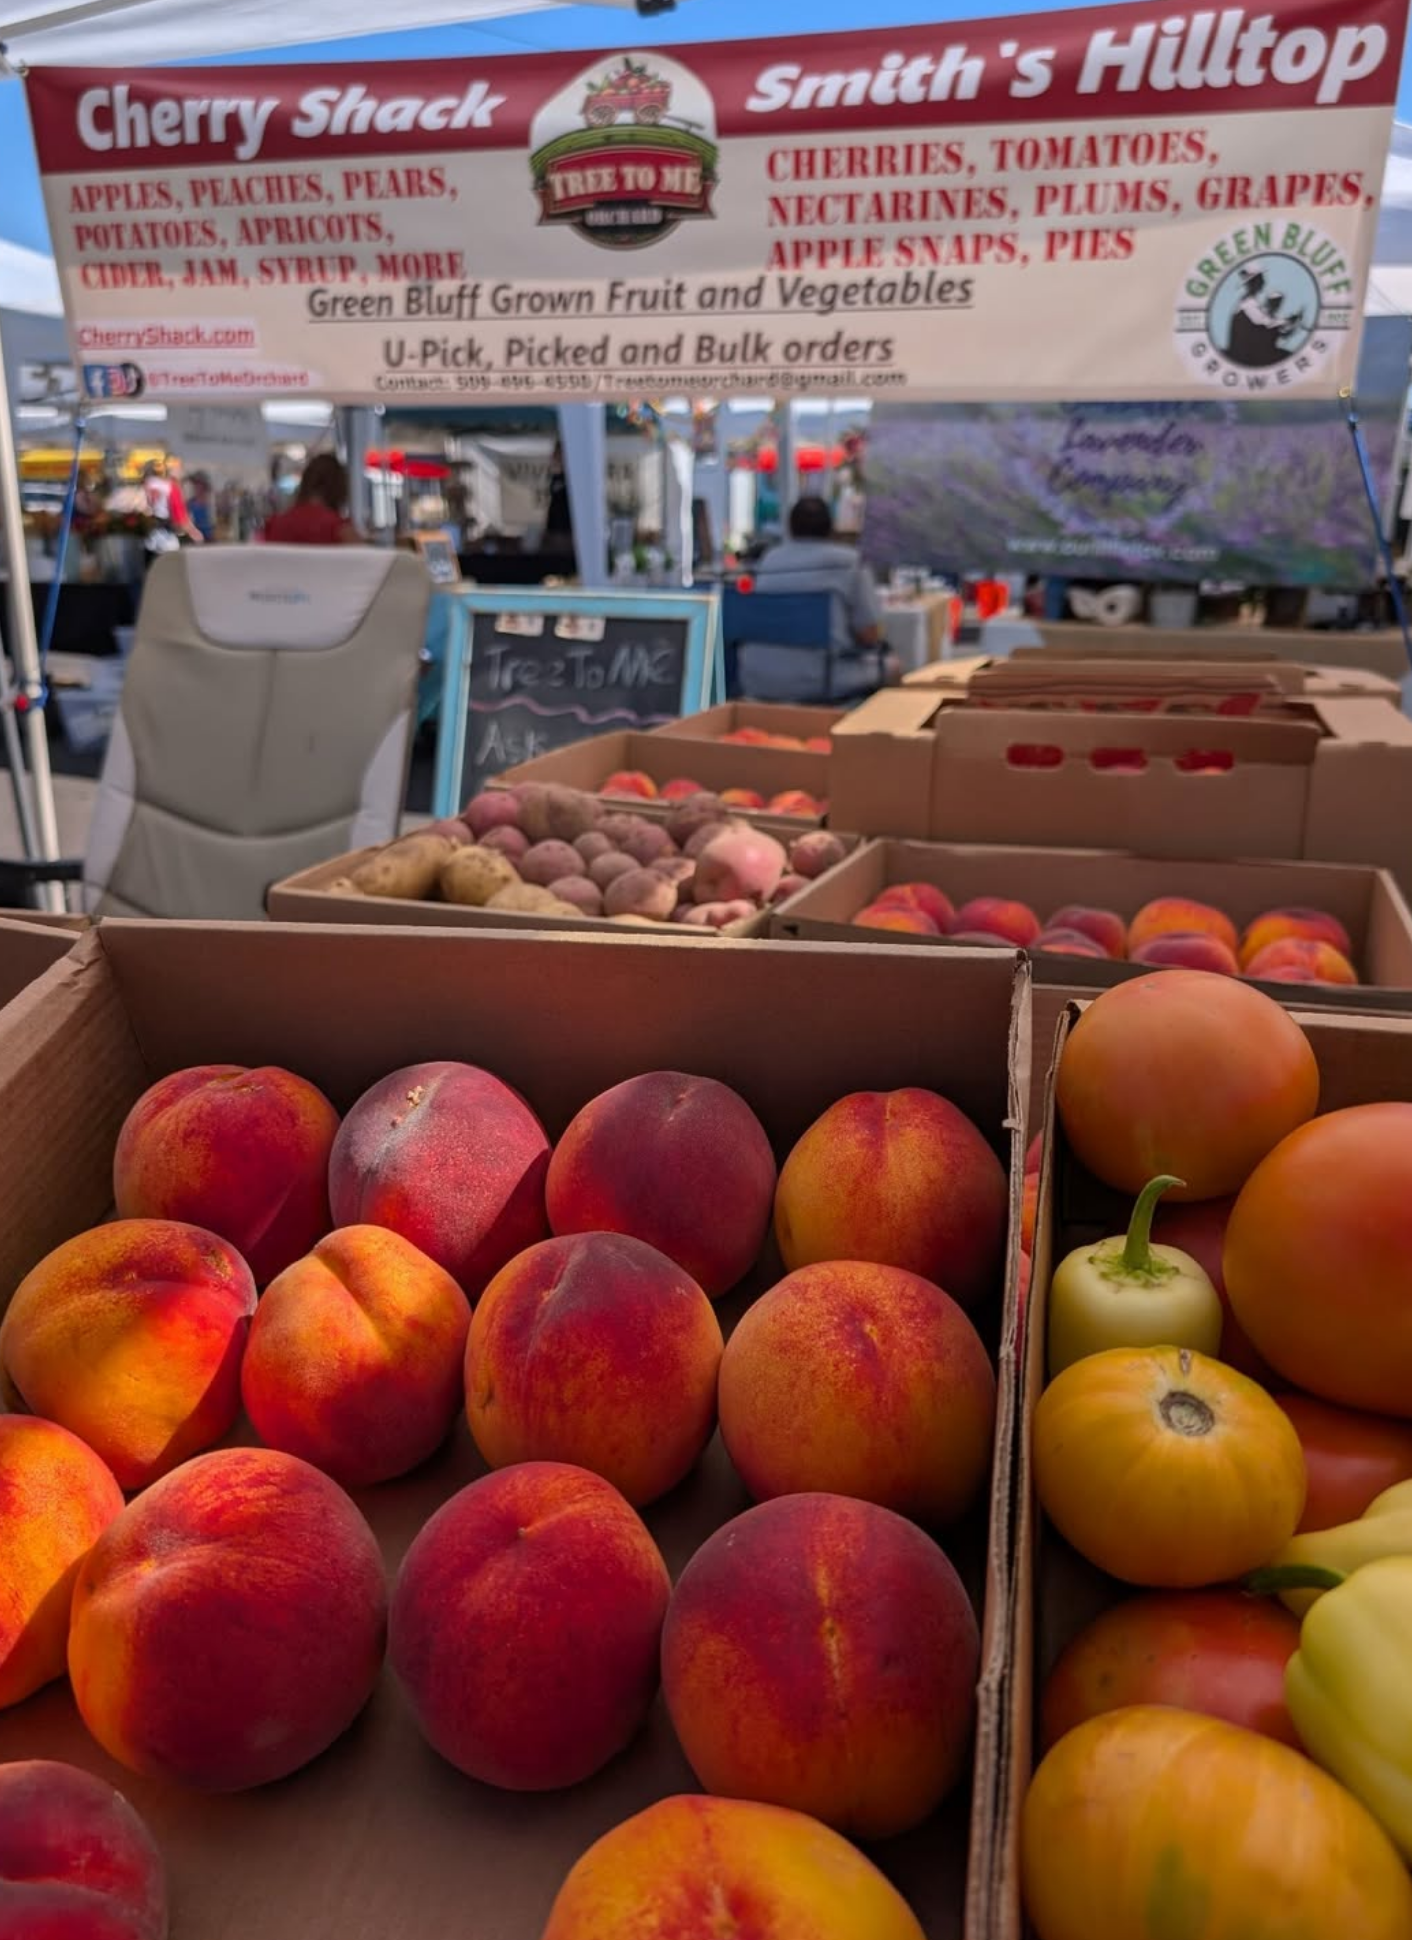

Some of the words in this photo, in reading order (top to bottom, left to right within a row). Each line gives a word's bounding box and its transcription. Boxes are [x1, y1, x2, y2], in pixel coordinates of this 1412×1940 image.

[1076, 8, 1389, 105] Hilltop
[76, 83, 279, 162] Cherry
[291, 80, 507, 139] Shack
[765, 142, 977, 182] CHERRIES,
[990, 130, 1220, 171] TOMATOES,
[69, 181, 184, 215] APPLES,
[189, 173, 334, 210] PEACHES,
[342, 167, 459, 202] PEARS,
[547, 166, 617, 201] TREE
[622, 164, 656, 192] TO
[660, 165, 702, 195] ME
[767, 187, 1020, 227] NECTARINES,
[1034, 178, 1182, 219] PLUMS,
[1198, 171, 1376, 211] GRAPES,
[74, 218, 229, 253] POTATOES,
[236, 212, 395, 247] APRICOTS,
[766, 236, 887, 271] APPLE
[894, 230, 1031, 269] SNAPS,
[1044, 228, 1136, 262] PIES
[80, 262, 174, 291] CIDER,
[182, 259, 251, 289] JAM,
[258, 254, 370, 286] SYRUP,
[376, 251, 466, 282] MORE
[1185, 222, 1273, 298] GREEN
[1280, 222, 1352, 295] BLUFF
[308, 287, 396, 318] Green
[405, 280, 483, 316] Bluff
[491, 282, 594, 314] Grown
[607, 277, 687, 311] Fruit
[699, 276, 766, 310] and
[779, 270, 975, 314] Vegetables
[78, 325, 256, 347] CherryShack.com
[382, 339, 494, 370] U-Pick,
[505, 333, 610, 367] Picked
[618, 335, 685, 364] and
[694, 331, 772, 363] Bulk
[783, 329, 894, 362] orders
[1190, 339, 1327, 390] GROWERS
